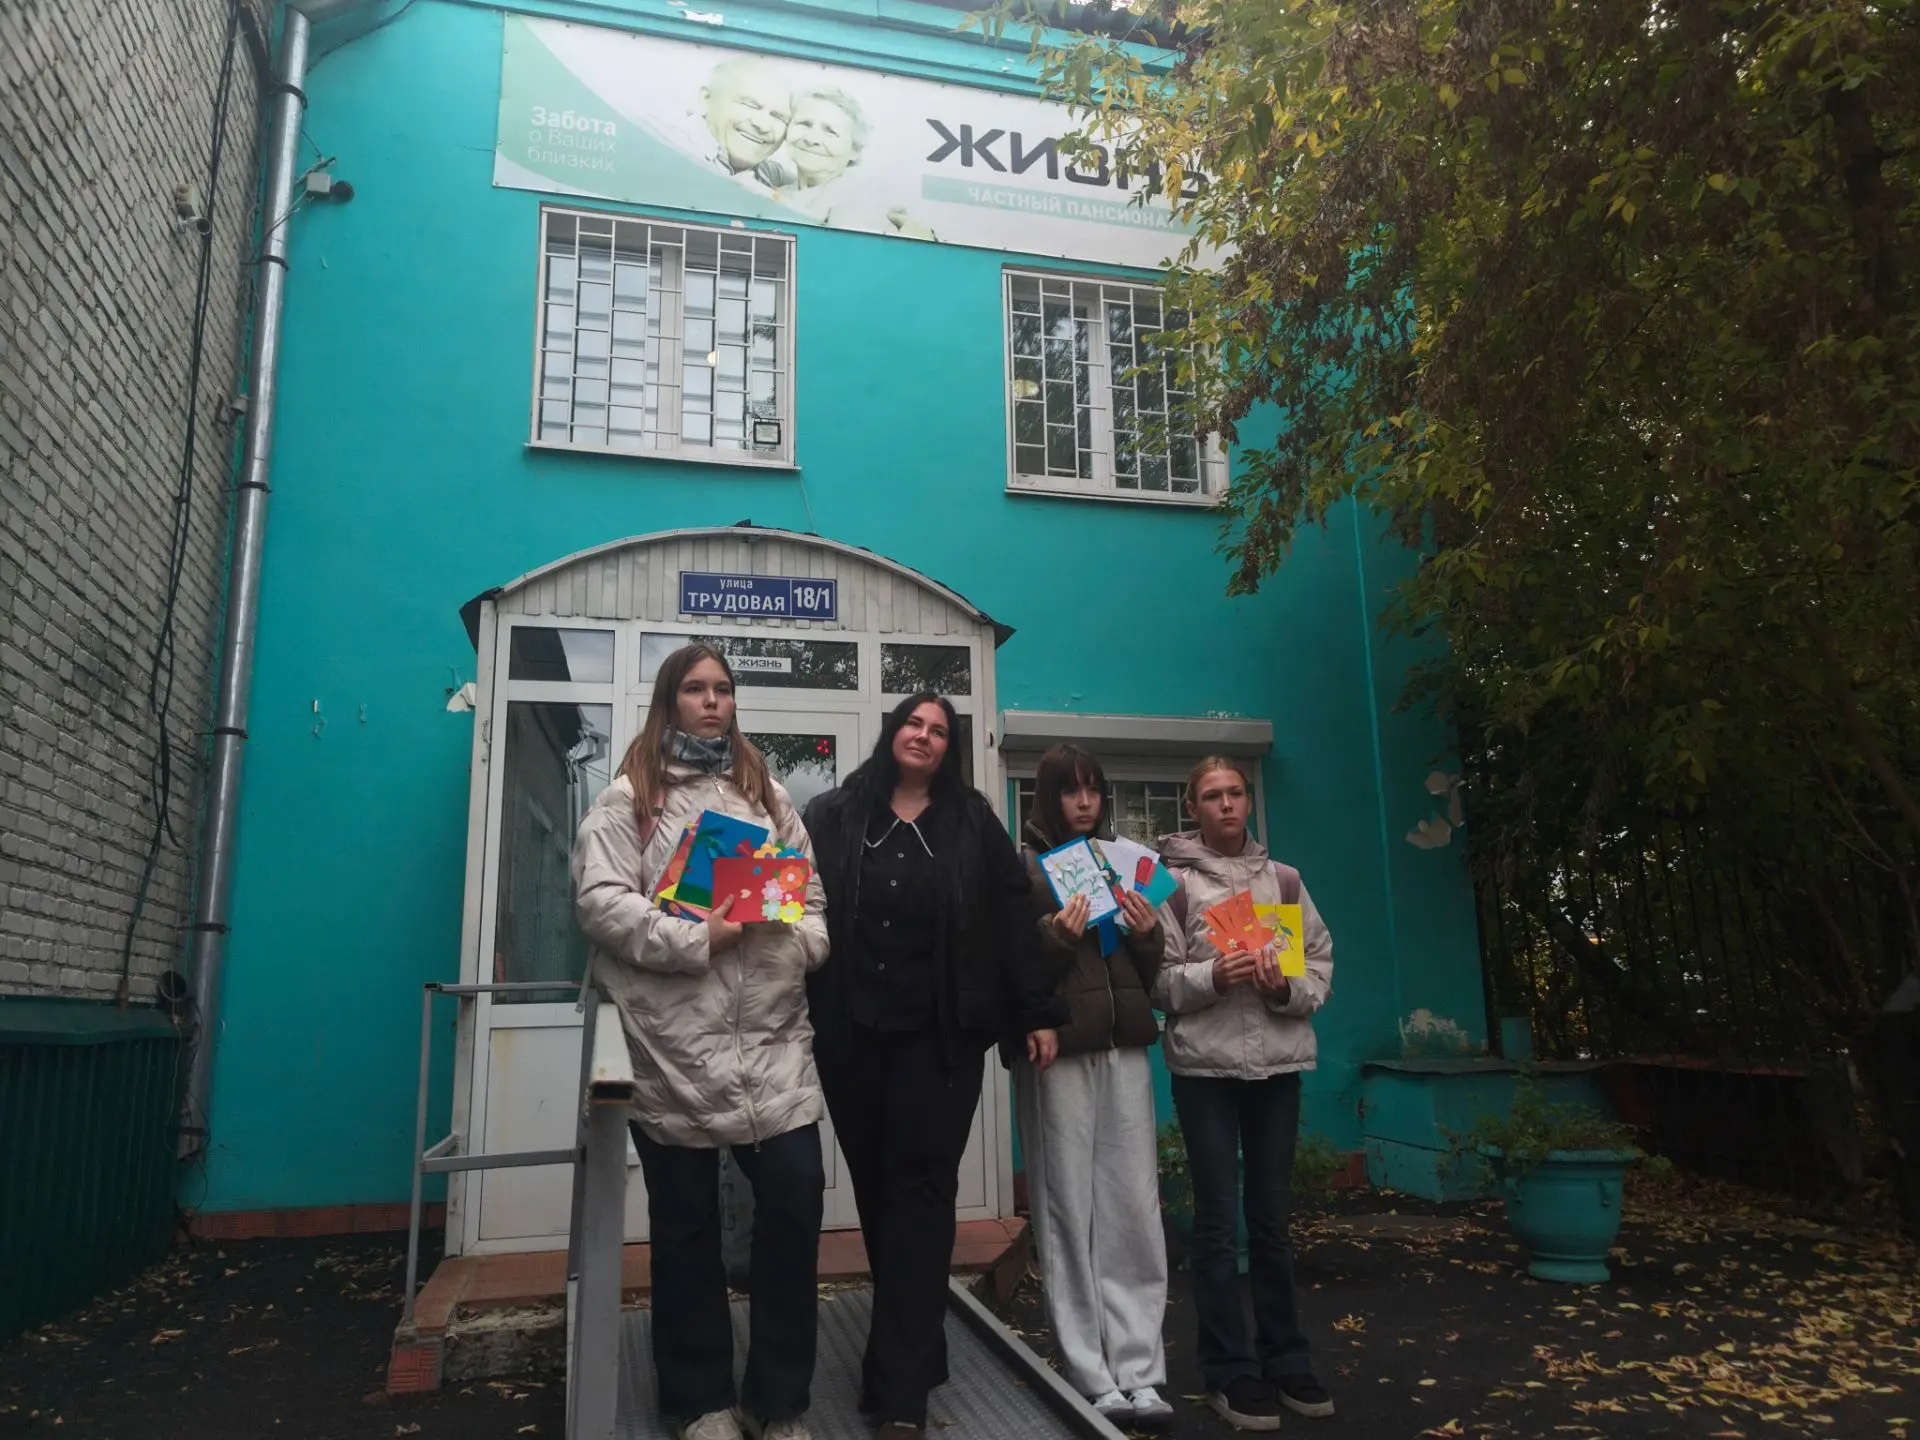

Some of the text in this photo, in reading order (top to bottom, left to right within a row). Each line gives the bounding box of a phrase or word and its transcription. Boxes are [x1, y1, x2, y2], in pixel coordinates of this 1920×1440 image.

[530, 105, 617, 137] Забота
[529, 128, 617, 154] о Ваших
[527, 145, 615, 173] близких
[967, 186, 1061, 213] ЧАСТНЫЙ
[720, 578, 753, 589] улица
[688, 592, 785, 611] ТРУДОВАЯ
[793, 587, 830, 611] 18/1
[738, 658, 782, 668] ЖИЗНЬ
